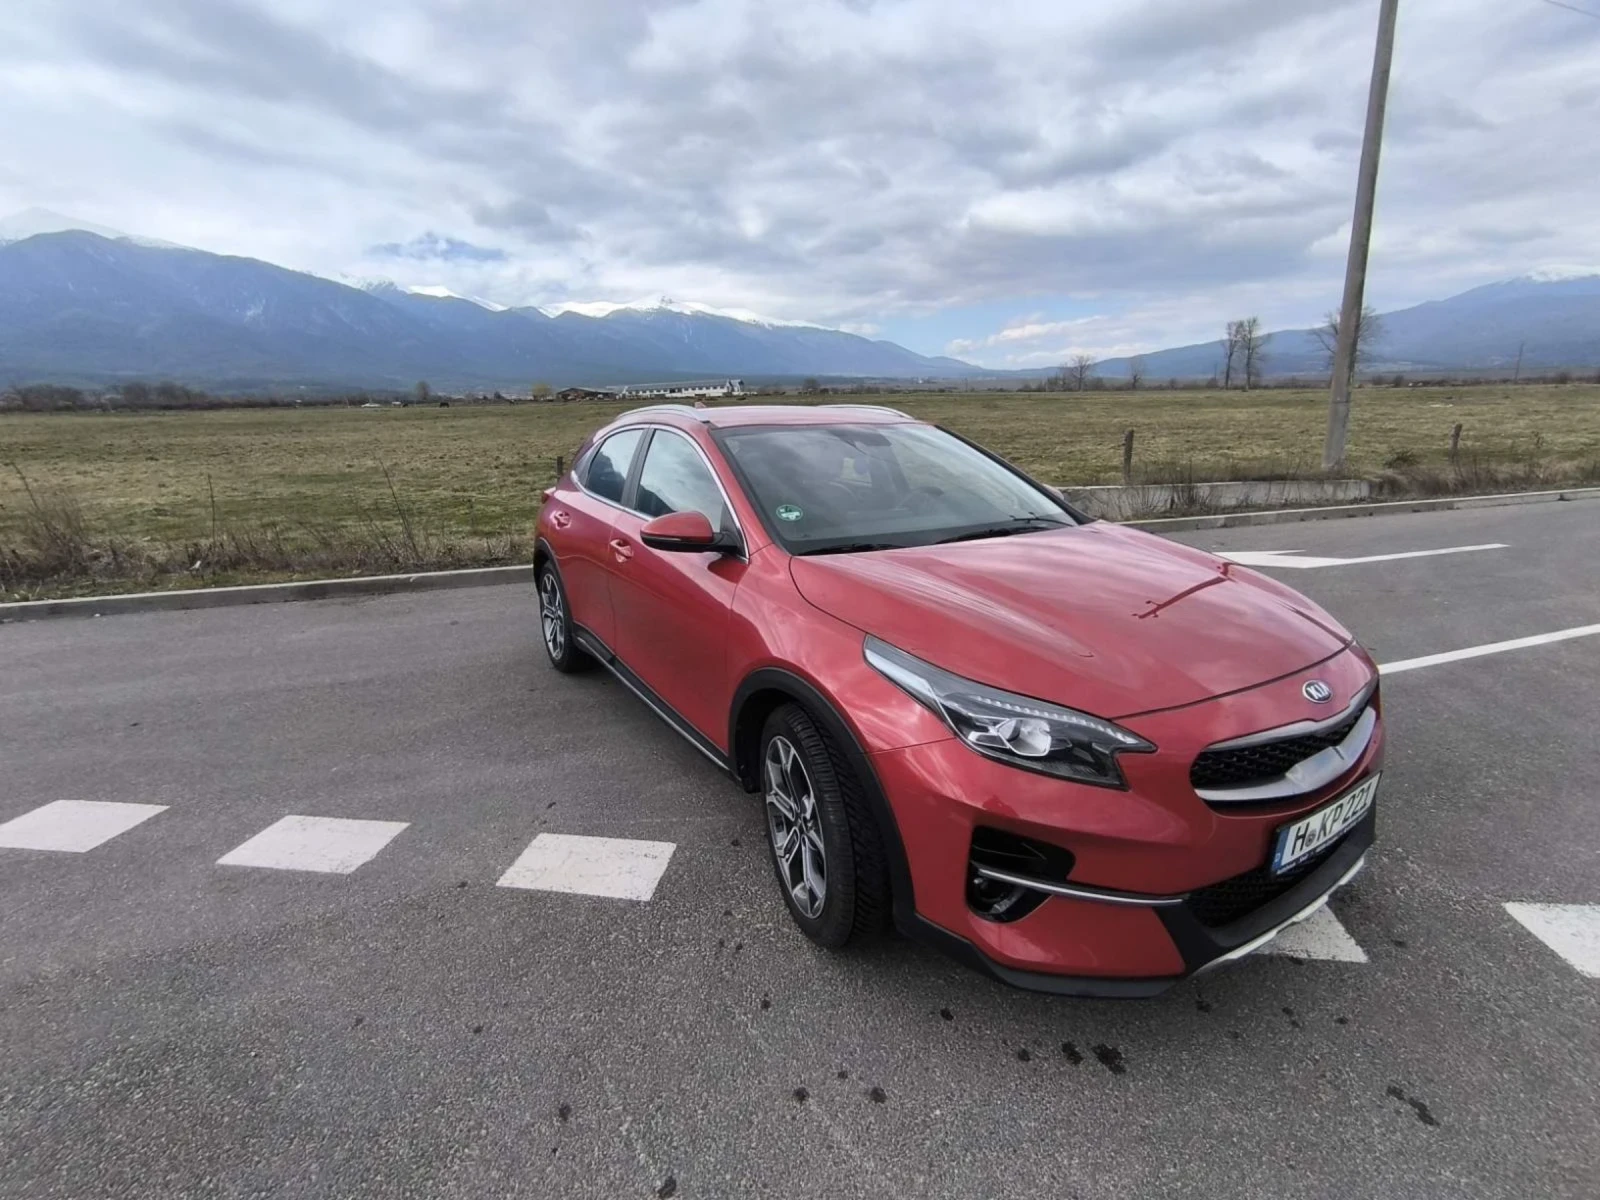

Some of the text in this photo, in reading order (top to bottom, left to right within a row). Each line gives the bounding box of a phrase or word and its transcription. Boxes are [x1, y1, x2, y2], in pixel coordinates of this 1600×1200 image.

[1291, 821, 1310, 856] H
[1317, 802, 1344, 841] KP
[1341, 781, 1372, 825] 221
